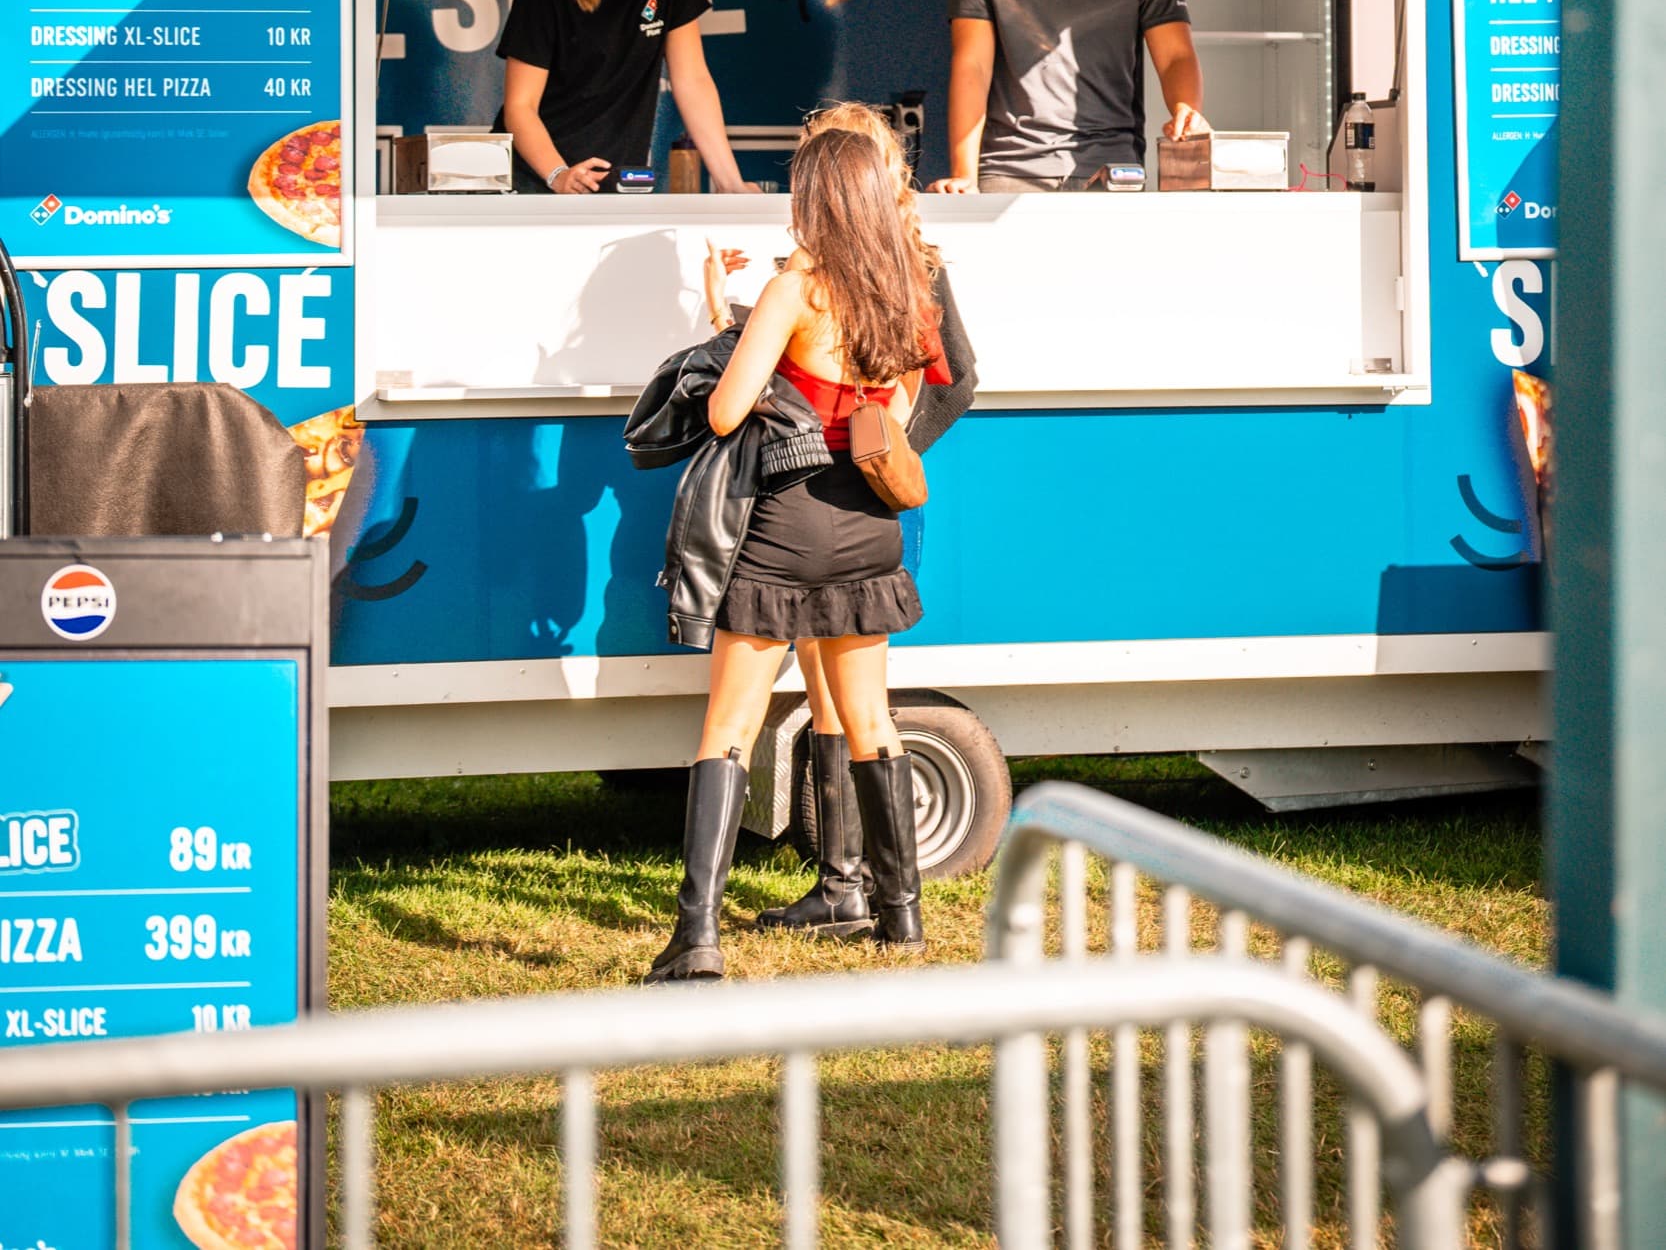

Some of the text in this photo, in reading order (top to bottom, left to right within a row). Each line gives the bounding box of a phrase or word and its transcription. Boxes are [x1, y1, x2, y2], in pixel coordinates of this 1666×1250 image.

[31, 26, 311, 47] DRESSING XL-SLICE 10 KR
[31, 77, 311, 98] DRESSING HEL PIZZA 40 KR
[49, 597, 109, 608] PEPSI
[169, 826, 217, 872] 89
[221, 842, 252, 870] KR
[144, 914, 217, 961] 399
[221, 929, 251, 957] KR
[5, 1004, 251, 1038] XL-SLICE 10 KR
